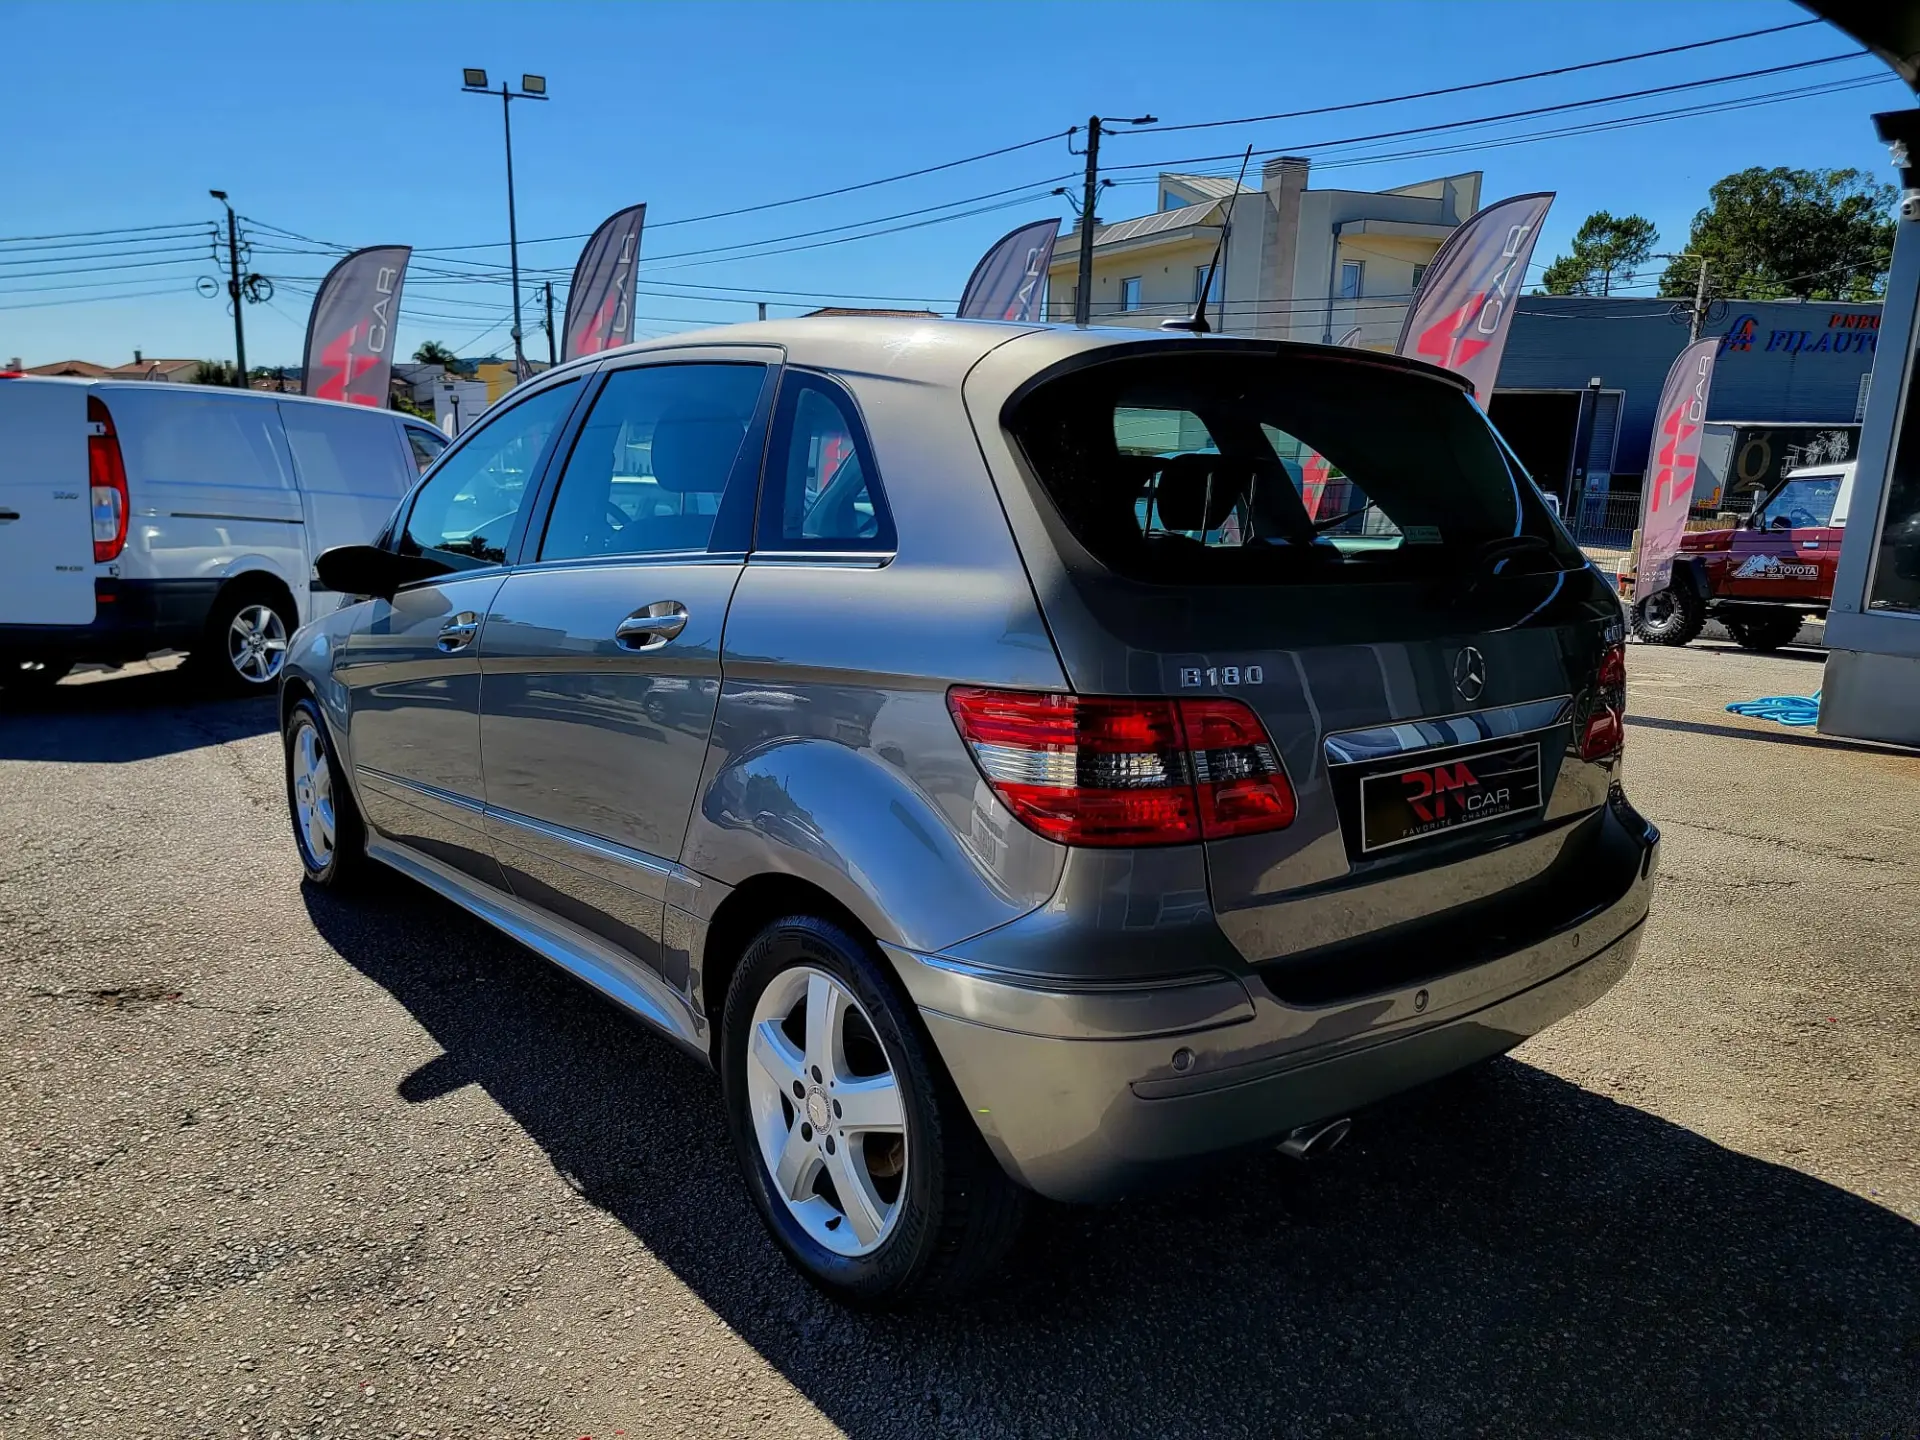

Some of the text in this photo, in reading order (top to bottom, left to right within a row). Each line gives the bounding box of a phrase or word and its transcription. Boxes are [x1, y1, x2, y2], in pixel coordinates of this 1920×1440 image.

[1478, 225, 1531, 335] CAR
[368, 266, 397, 353] CAR
[1689, 354, 1711, 423] CAR
[1778, 566, 1817, 575] TOYOTA
[1402, 804, 1511, 837] FAVORITE CHAMPION
[1467, 788, 1510, 811] CAR
